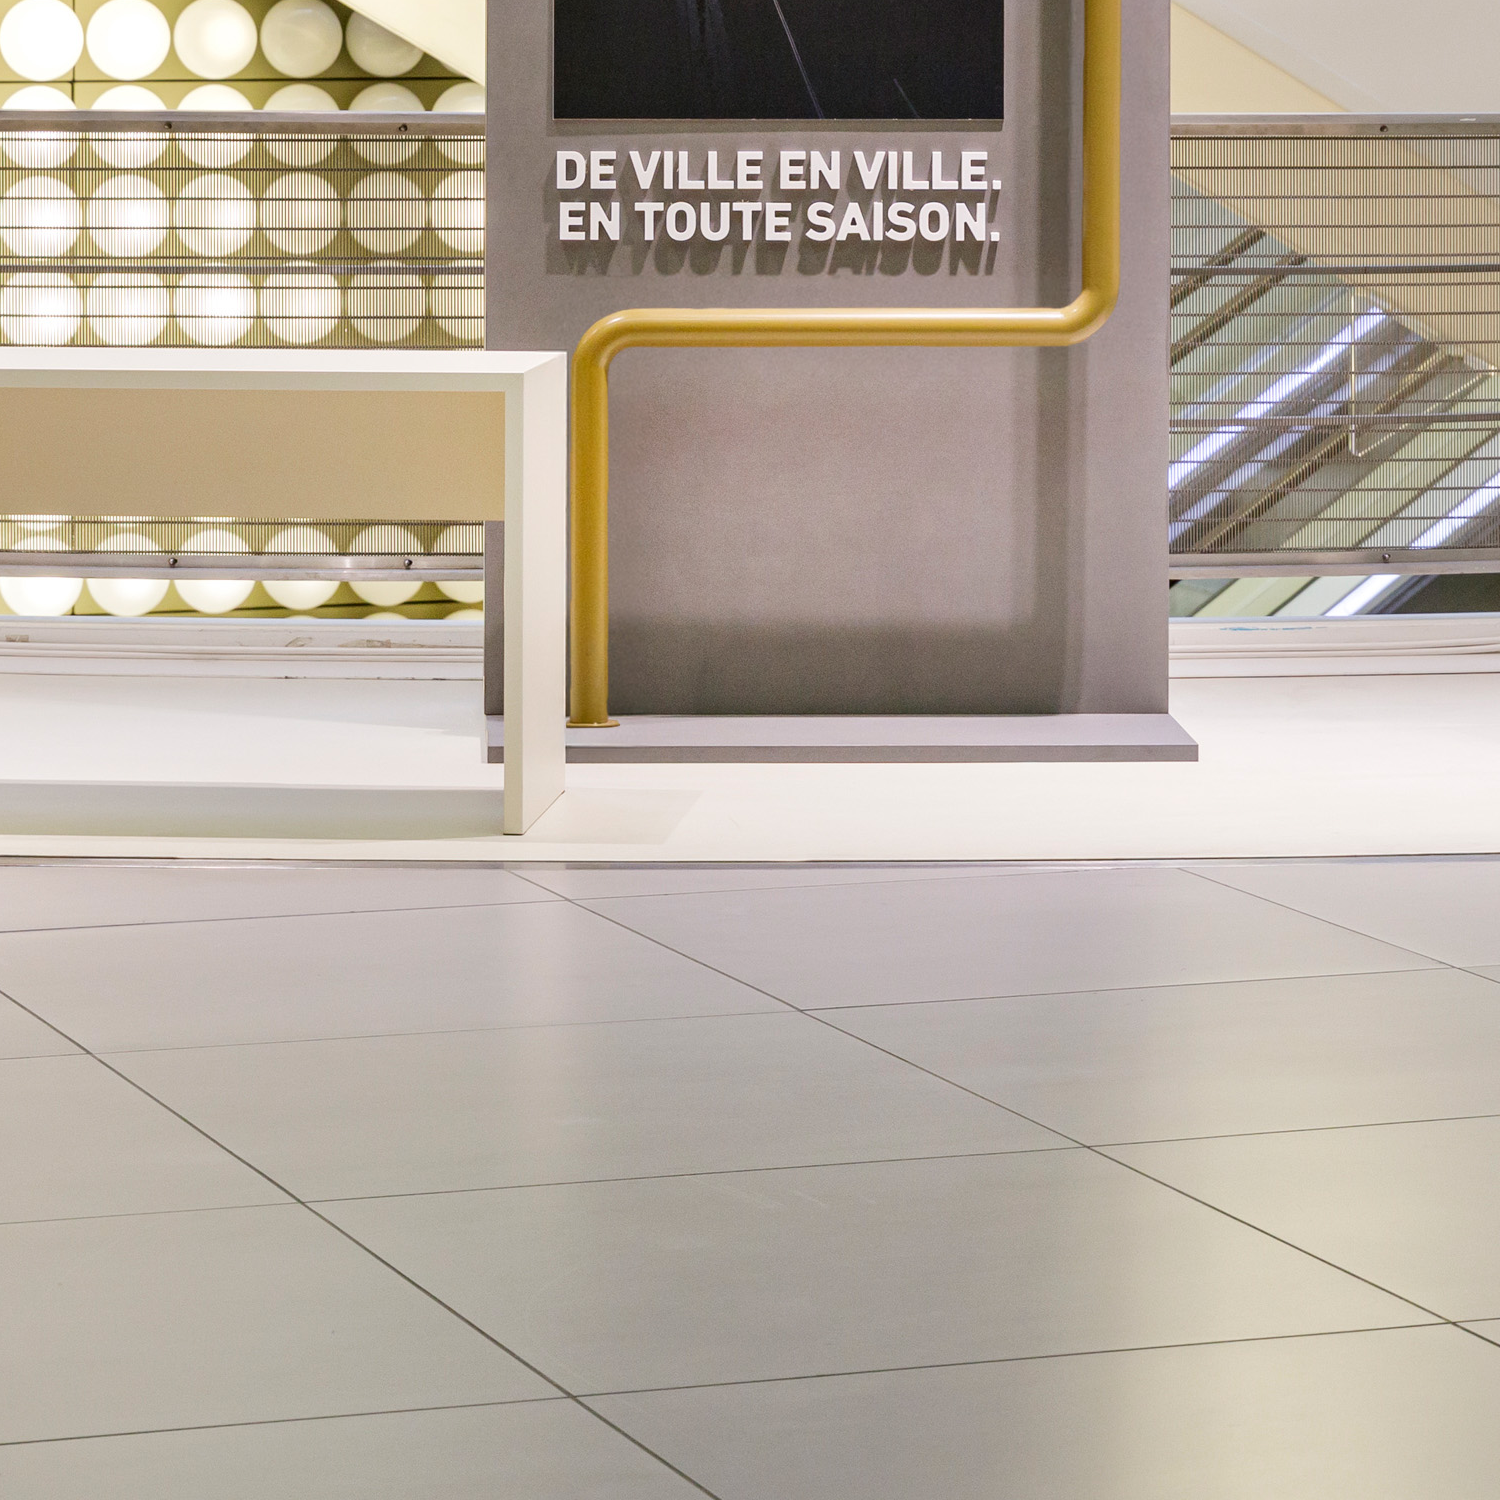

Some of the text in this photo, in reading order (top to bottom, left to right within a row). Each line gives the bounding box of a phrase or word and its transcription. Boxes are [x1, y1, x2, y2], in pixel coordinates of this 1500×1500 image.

[556, 151, 1001, 190] DE VILLE EN VILLE.
[559, 202, 1000, 242] EN TOUTE SAISON.
